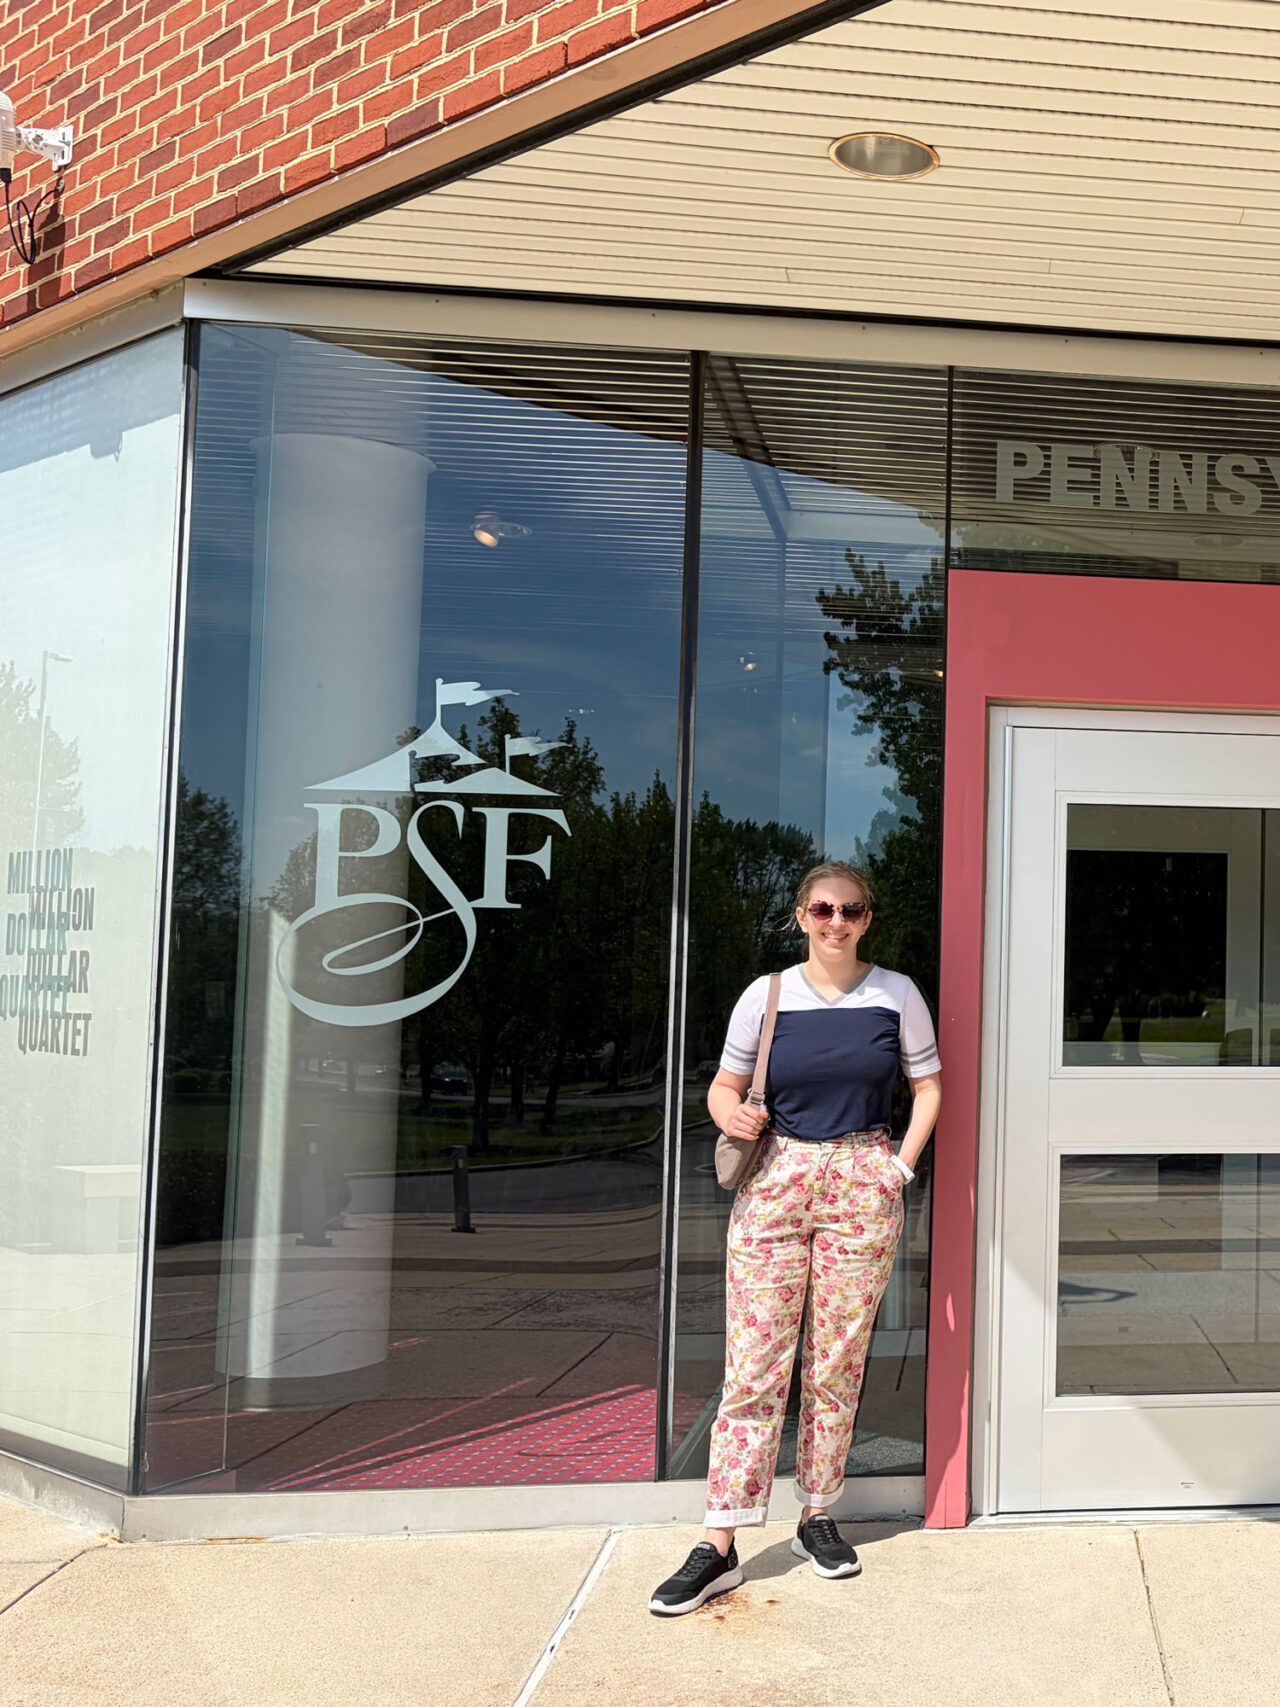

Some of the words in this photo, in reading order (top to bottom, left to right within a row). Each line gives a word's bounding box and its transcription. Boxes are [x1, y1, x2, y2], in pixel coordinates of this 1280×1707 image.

[7, 848, 73, 894] MILLION
[5, 912, 68, 956] DOLLAR
[0, 974, 71, 1021] QUARTET
[18, 1012, 92, 1057] QUARTET
